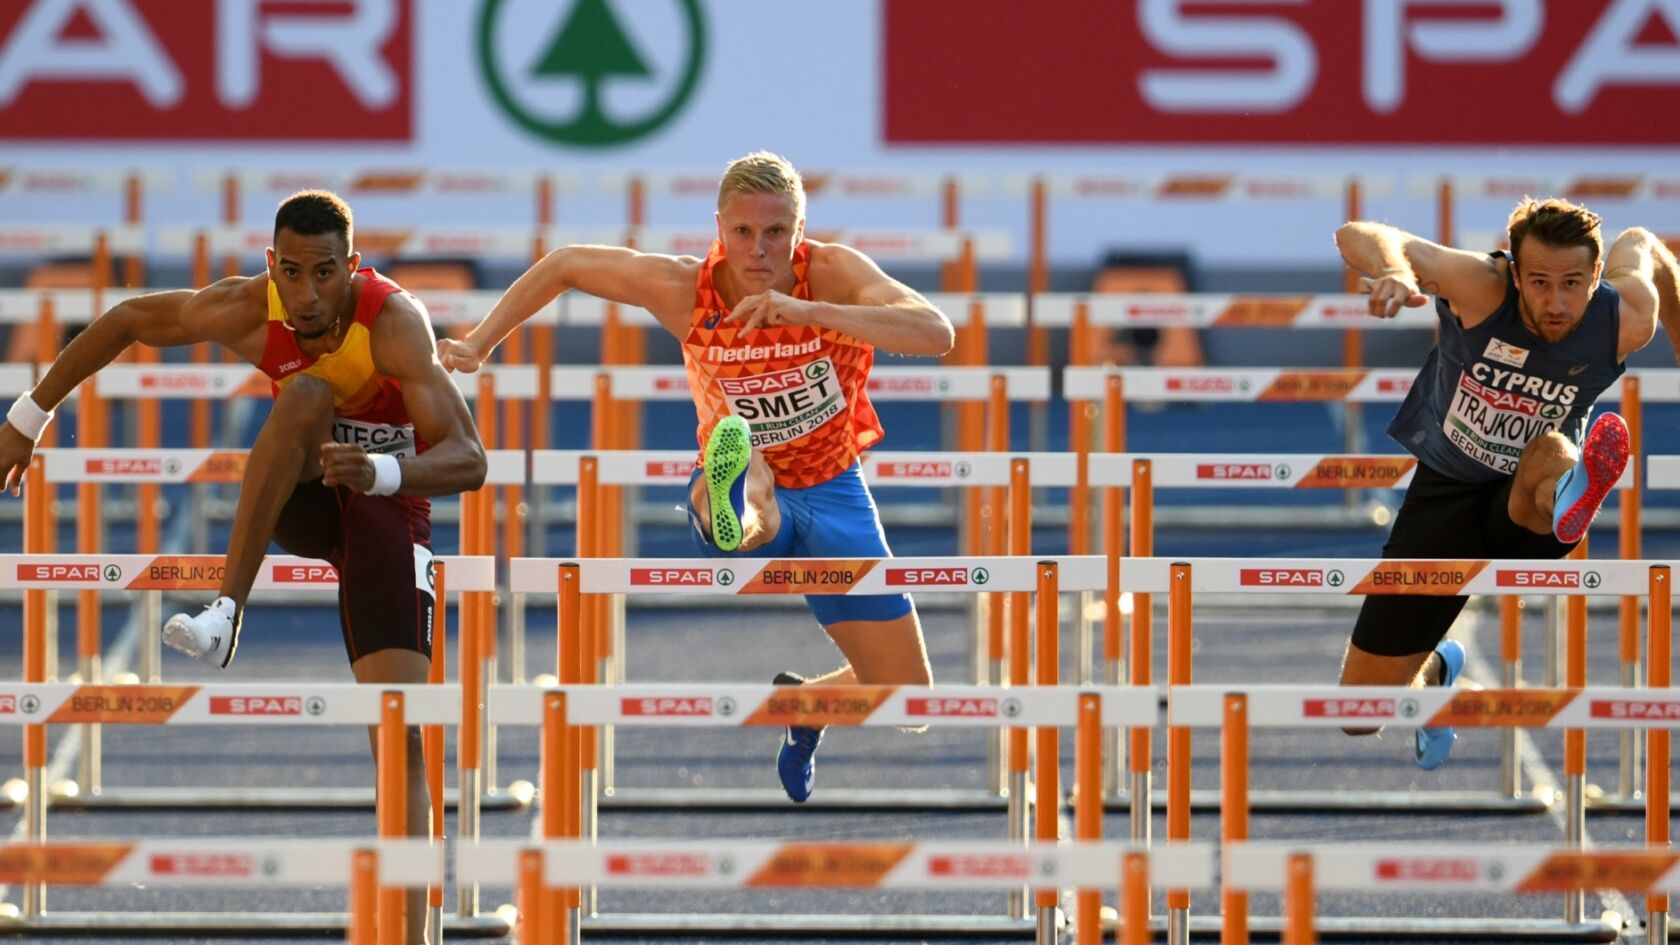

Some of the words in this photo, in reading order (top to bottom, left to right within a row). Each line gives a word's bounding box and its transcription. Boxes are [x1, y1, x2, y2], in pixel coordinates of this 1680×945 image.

[0, 0, 399, 109] AR
[1137, 0, 1680, 115] SPA
[723, 371, 803, 394] SPAR
[1472, 362, 1579, 405] CYPRUS
[735, 376, 829, 420] SMET
[1463, 375, 1538, 413] SPAR
[332, 423, 404, 445] TEGA
[751, 424, 804, 447] BERLIN
[806, 404, 838, 430] 2018
[1451, 429, 1496, 467] BERLIN
[1499, 458, 1518, 473] 20
[102, 460, 161, 472] SPAR
[892, 464, 950, 476] SPAR
[1213, 465, 1270, 478] SPAR
[1317, 466, 1365, 479] BERLIN
[1369, 466, 1399, 479] 2018
[36, 566, 99, 579] SPAR
[150, 566, 204, 580] BERLIN
[208, 567, 225, 580] 20
[292, 568, 338, 580] SPA
[649, 571, 712, 583] SPAR
[763, 570, 816, 584] BERLIN
[821, 571, 854, 584] 2018
[904, 570, 967, 583] SPAR
[1259, 571, 1322, 584] SPAR
[1373, 571, 1427, 585] BERLIN
[1431, 572, 1464, 585] 2018
[1515, 572, 1578, 585] SPAR
[71, 696, 133, 712] BERLIN
[137, 697, 173, 712] 2018
[230, 698, 301, 713] SPAR
[640, 699, 712, 714] SPAR
[768, 699, 828, 714] BERLIN
[833, 699, 870, 714] 2018
[926, 700, 995, 714] SPAR
[1324, 700, 1394, 715] SPAR
[1611, 701, 1680, 717] SPAR
